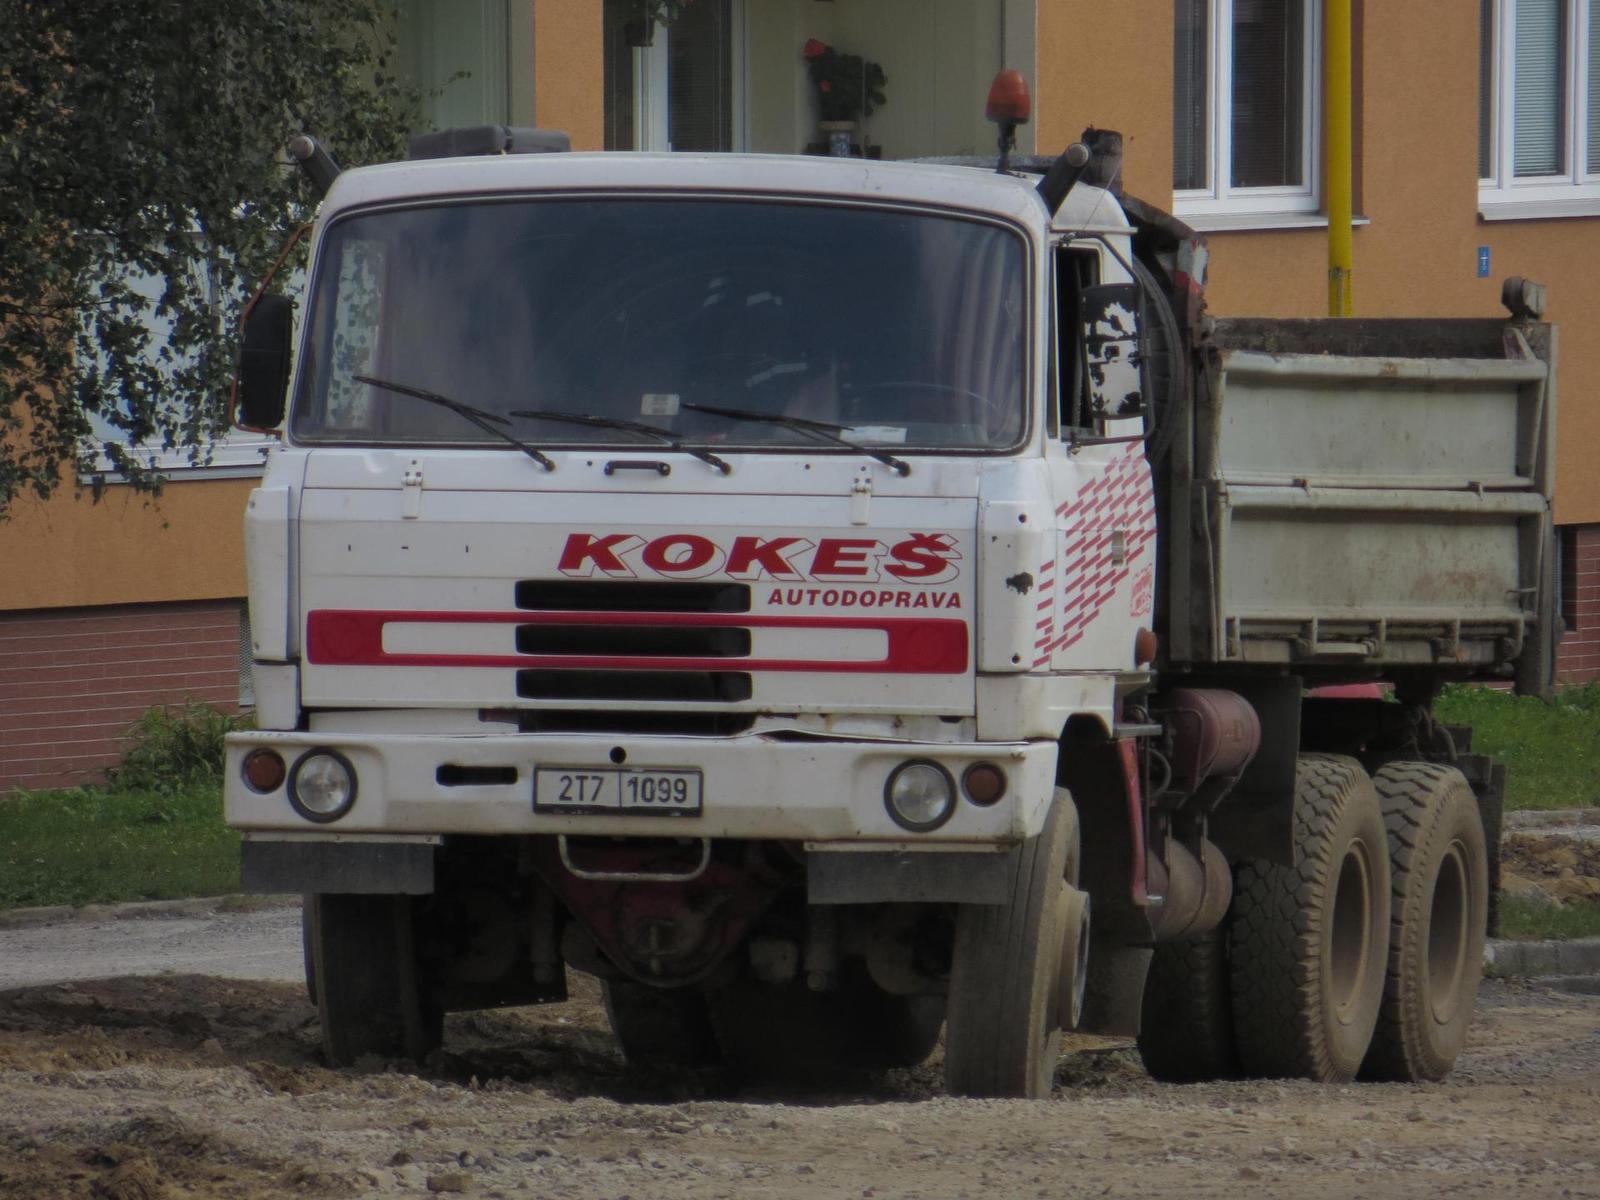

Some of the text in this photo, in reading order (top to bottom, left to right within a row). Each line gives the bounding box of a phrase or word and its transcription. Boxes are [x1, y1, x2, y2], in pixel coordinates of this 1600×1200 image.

[558, 532, 961, 584] KOKEŠ
[767, 588, 962, 610] AUTODOPRAVA
[558, 775, 687, 803] 2T7 1099
